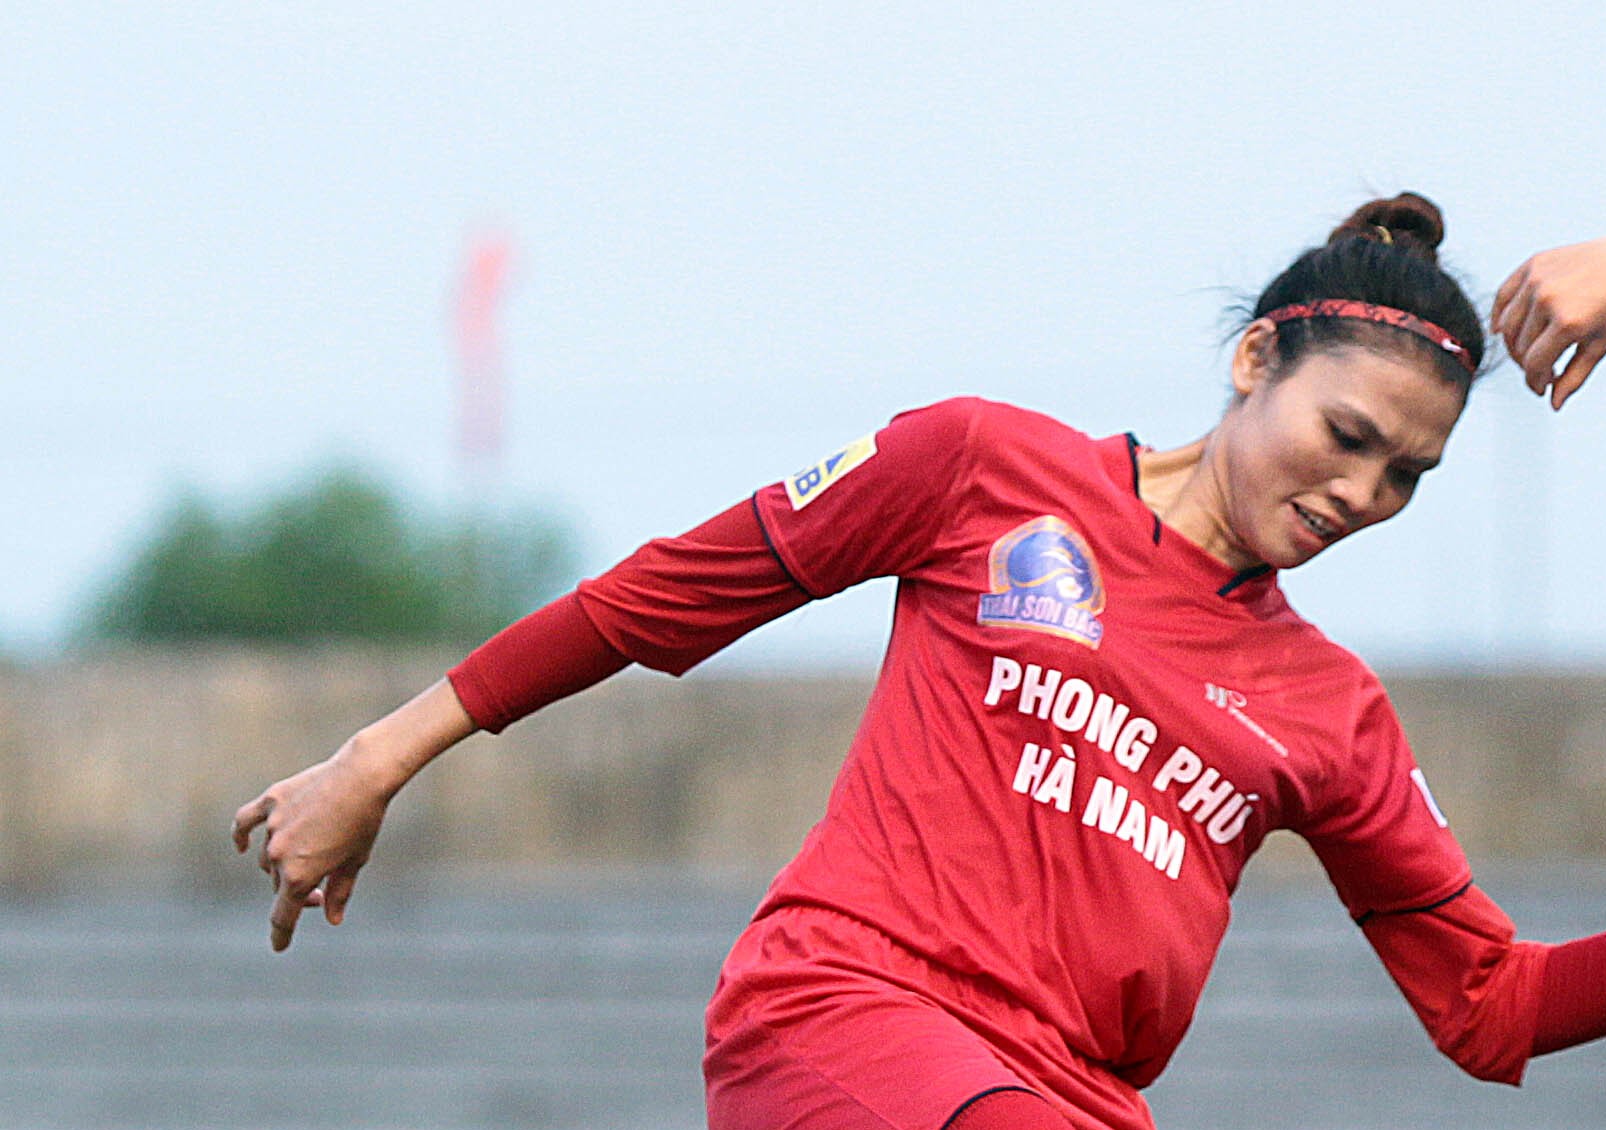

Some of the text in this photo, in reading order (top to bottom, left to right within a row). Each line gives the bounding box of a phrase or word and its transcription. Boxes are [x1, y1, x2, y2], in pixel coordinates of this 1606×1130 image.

[984, 656, 1158, 773] PHONG
[1152, 745, 1260, 845] PHÚ
[1012, 742, 1186, 880] HÀ NAM
